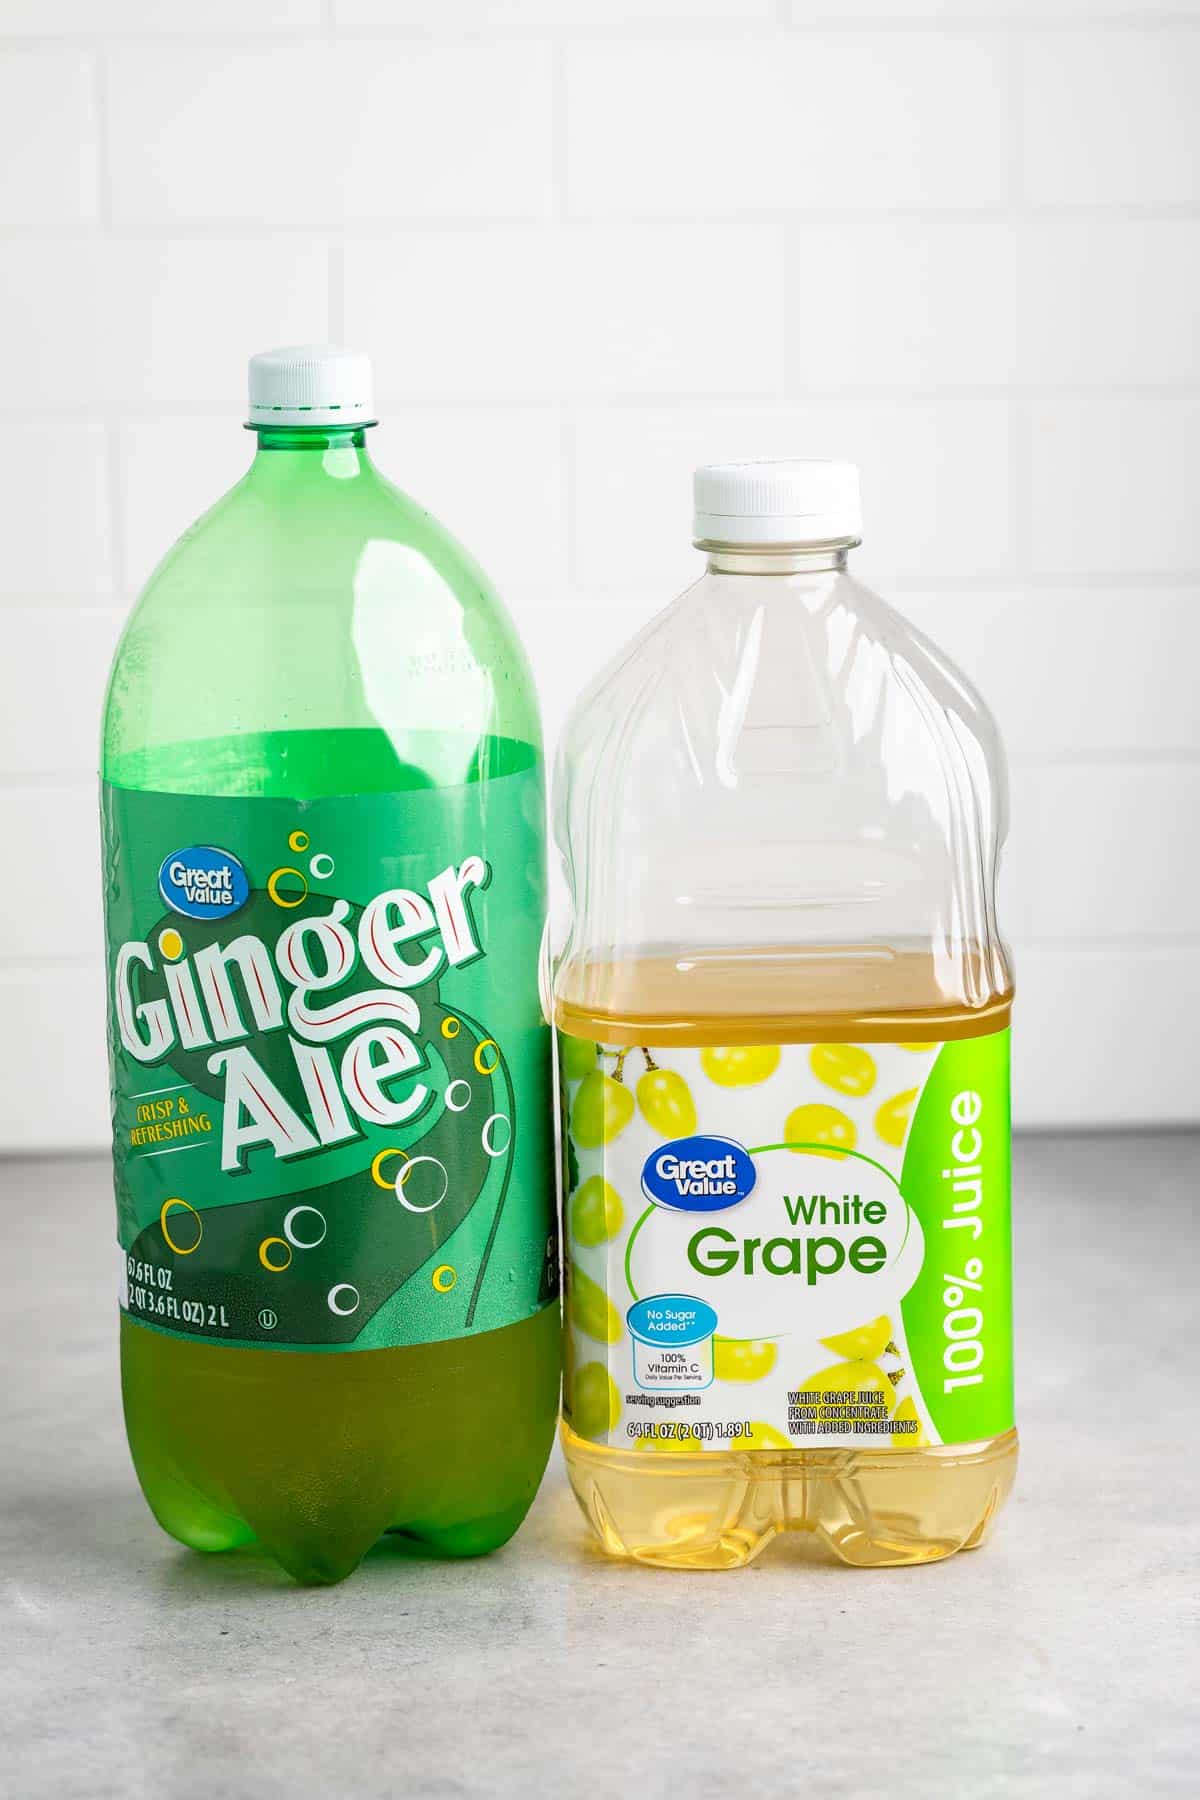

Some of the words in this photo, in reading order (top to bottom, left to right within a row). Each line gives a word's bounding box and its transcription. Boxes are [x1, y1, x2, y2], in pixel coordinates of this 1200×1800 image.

[169, 861, 233, 890] Great
[185, 886, 233, 905] Value
[115, 855, 489, 1063] Ginger
[136, 1099, 174, 1123] CRISP
[178, 1096, 189, 1114] &
[207, 1026, 430, 1172] Ale
[130, 1113, 212, 1146] REFRESHING
[655, 1154, 737, 1181] Great
[941, 1090, 984, 1241] Juice
[675, 1178, 737, 1196] Value
[783, 1195, 888, 1226] White
[686, 1227, 888, 1286] Grape
[144, 1263, 157, 1287] FL
[157, 1267, 173, 1291] OZ
[135, 1285, 147, 1310] QT
[149, 1291, 166, 1315] 3.6
[167, 1295, 181, 1320] FL
[182, 1300, 205, 1328] OZ)
[207, 1305, 217, 1327] 2
[220, 1305, 230, 1328] L
[647, 1310, 663, 1320] No
[665, 1310, 696, 1321] Sugar
[942, 1256, 985, 1395] 100%
[647, 1363, 688, 1373] Vitamin
[690, 1363, 700, 1373] C
[660, 1353, 687, 1363] 100%
[625, 1393, 655, 1408] serving
[656, 1394, 702, 1409] suggestion
[787, 1392, 821, 1405] WHITE
[822, 1392, 855, 1405] GRAPE
[856, 1392, 885, 1405] JUICE
[788, 1406, 818, 1420] FROM
[819, 1406, 888, 1420] CONCENTRATE
[627, 1422, 641, 1437] 64
[643, 1423, 657, 1438] FL
[659, 1423, 676, 1438] OZ
[678, 1423, 690, 1441] (2
[692, 1422, 713, 1440] QT)
[716, 1421, 742, 1438] 1.89
[744, 1421, 753, 1437] L
[788, 1421, 816, 1435] WITH
[817, 1421, 851, 1434] ADDED
[853, 1421, 918, 1434] INGREDIENTS
